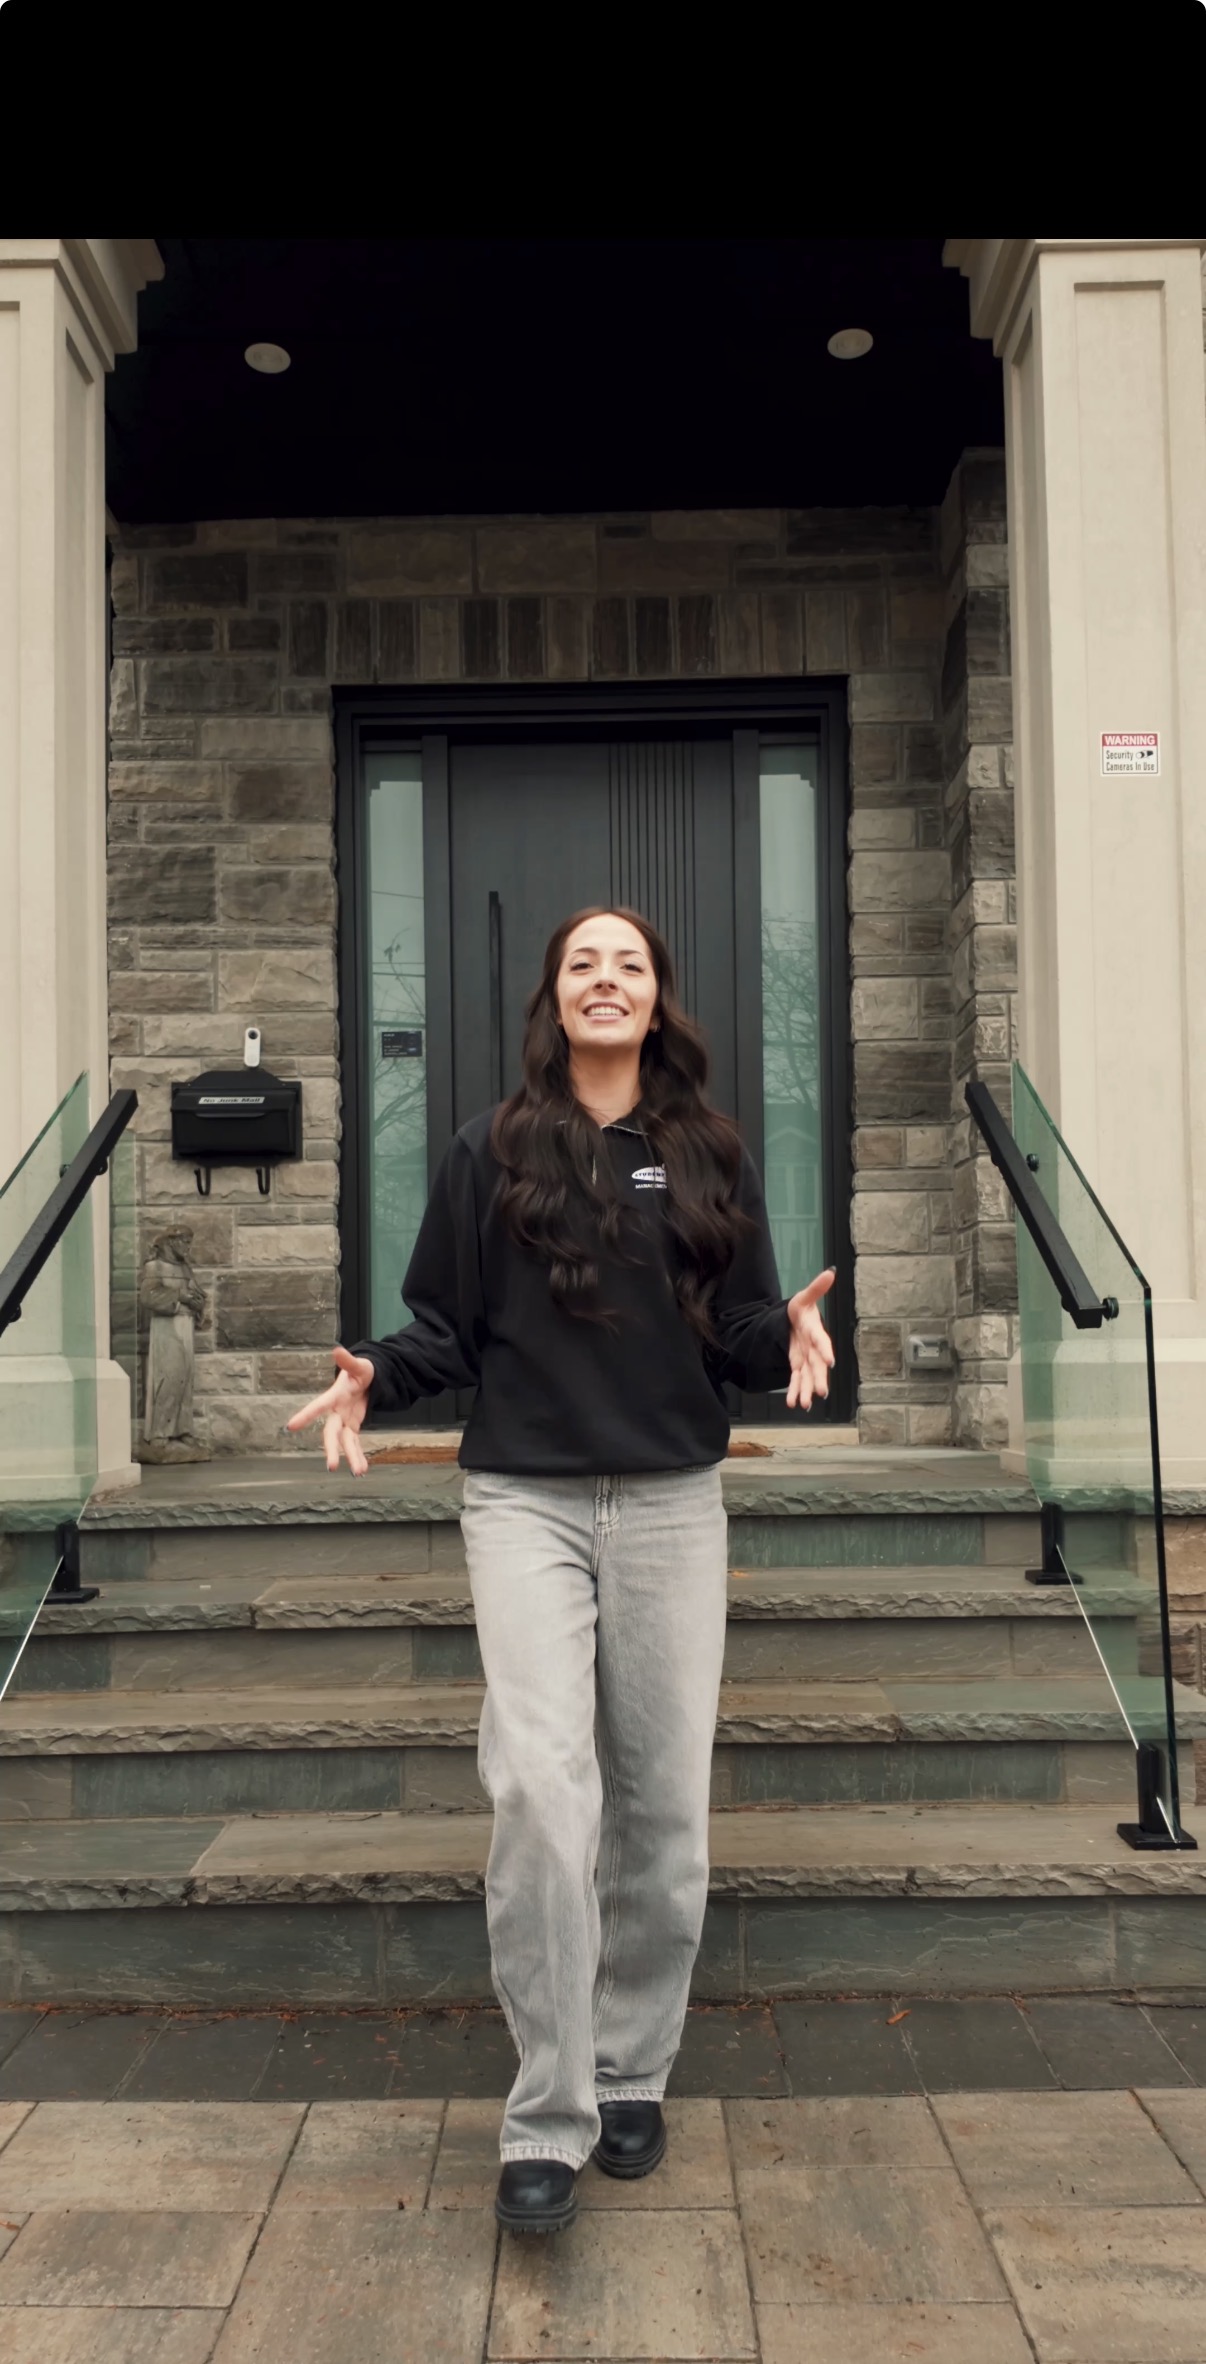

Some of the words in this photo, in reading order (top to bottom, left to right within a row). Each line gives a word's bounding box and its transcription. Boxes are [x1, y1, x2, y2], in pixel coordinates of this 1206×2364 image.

[1104, 735, 1156, 746] WARNING
[1106, 750, 1134, 761] Security
[1106, 762, 1134, 771] Cameras
[1135, 762, 1142, 771] In
[1143, 762, 1155, 771] Use
